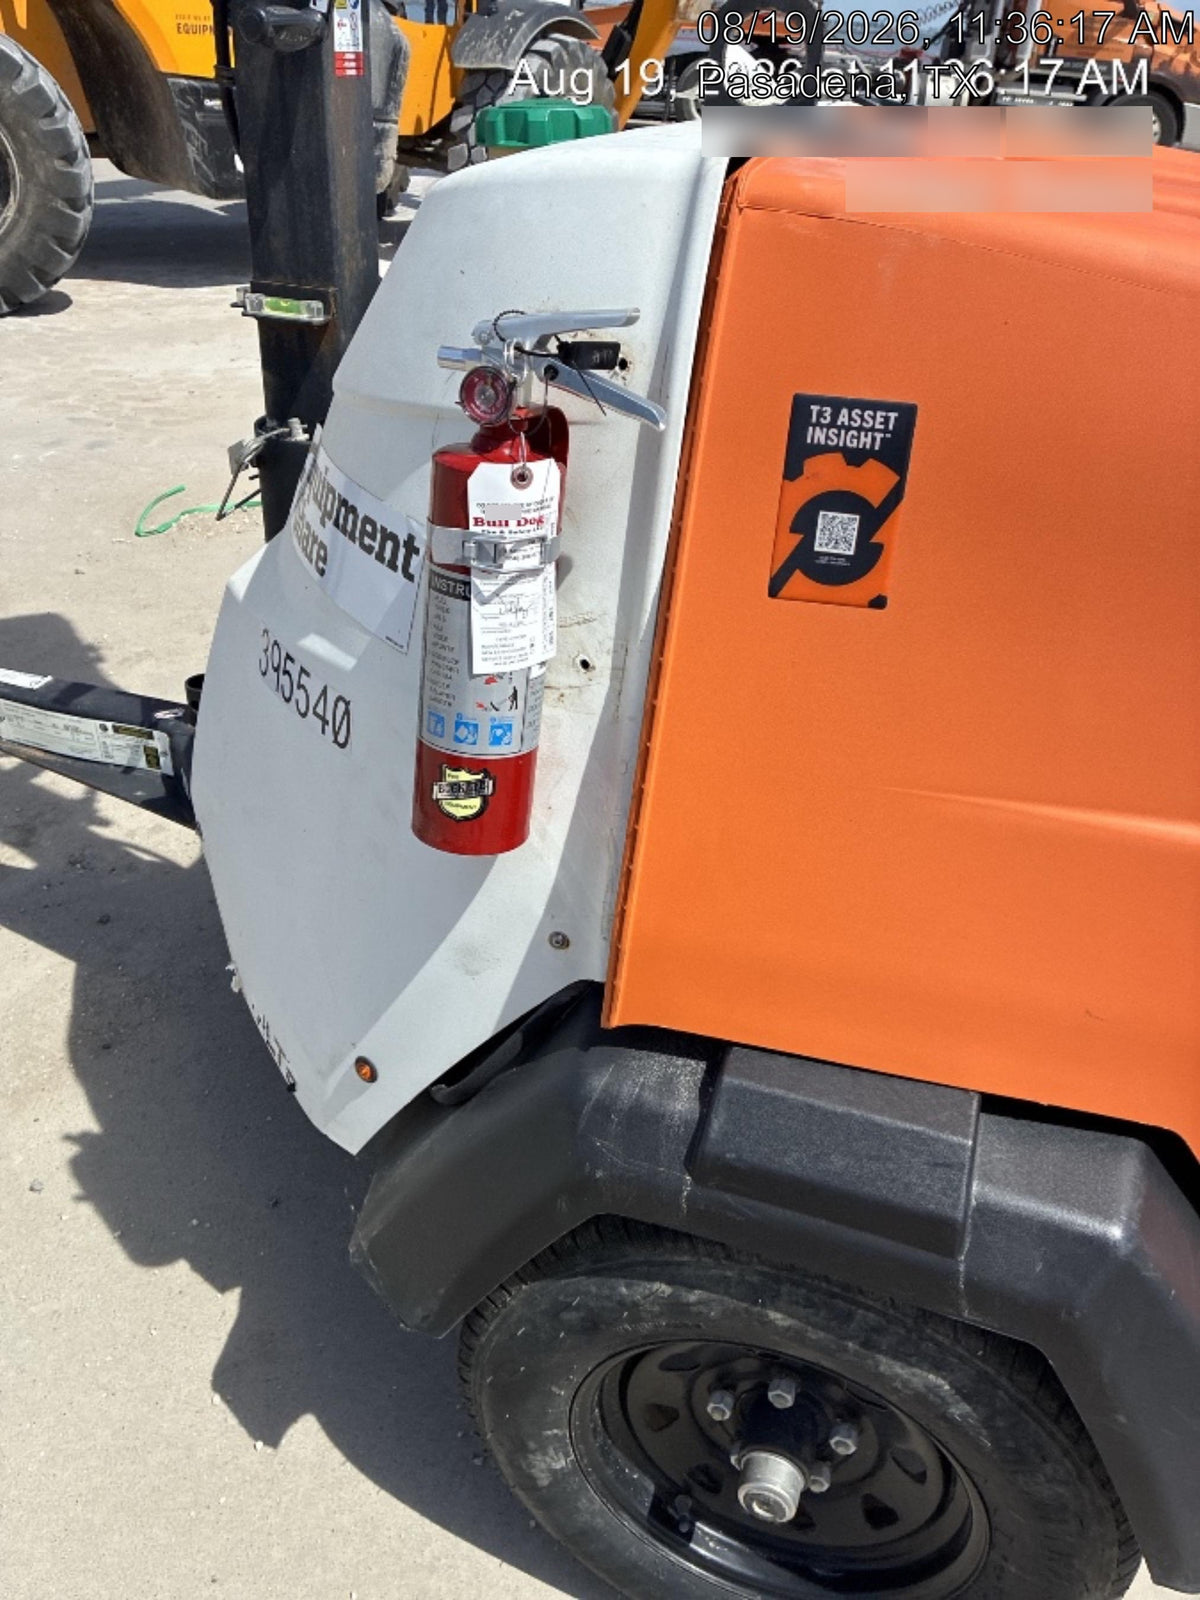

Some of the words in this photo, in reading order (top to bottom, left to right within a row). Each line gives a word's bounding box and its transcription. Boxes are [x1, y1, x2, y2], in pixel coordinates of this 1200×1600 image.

[810, 405, 832, 425] T3
[837, 408, 899, 431] ASSET
[259, 628, 351, 749] 395540
